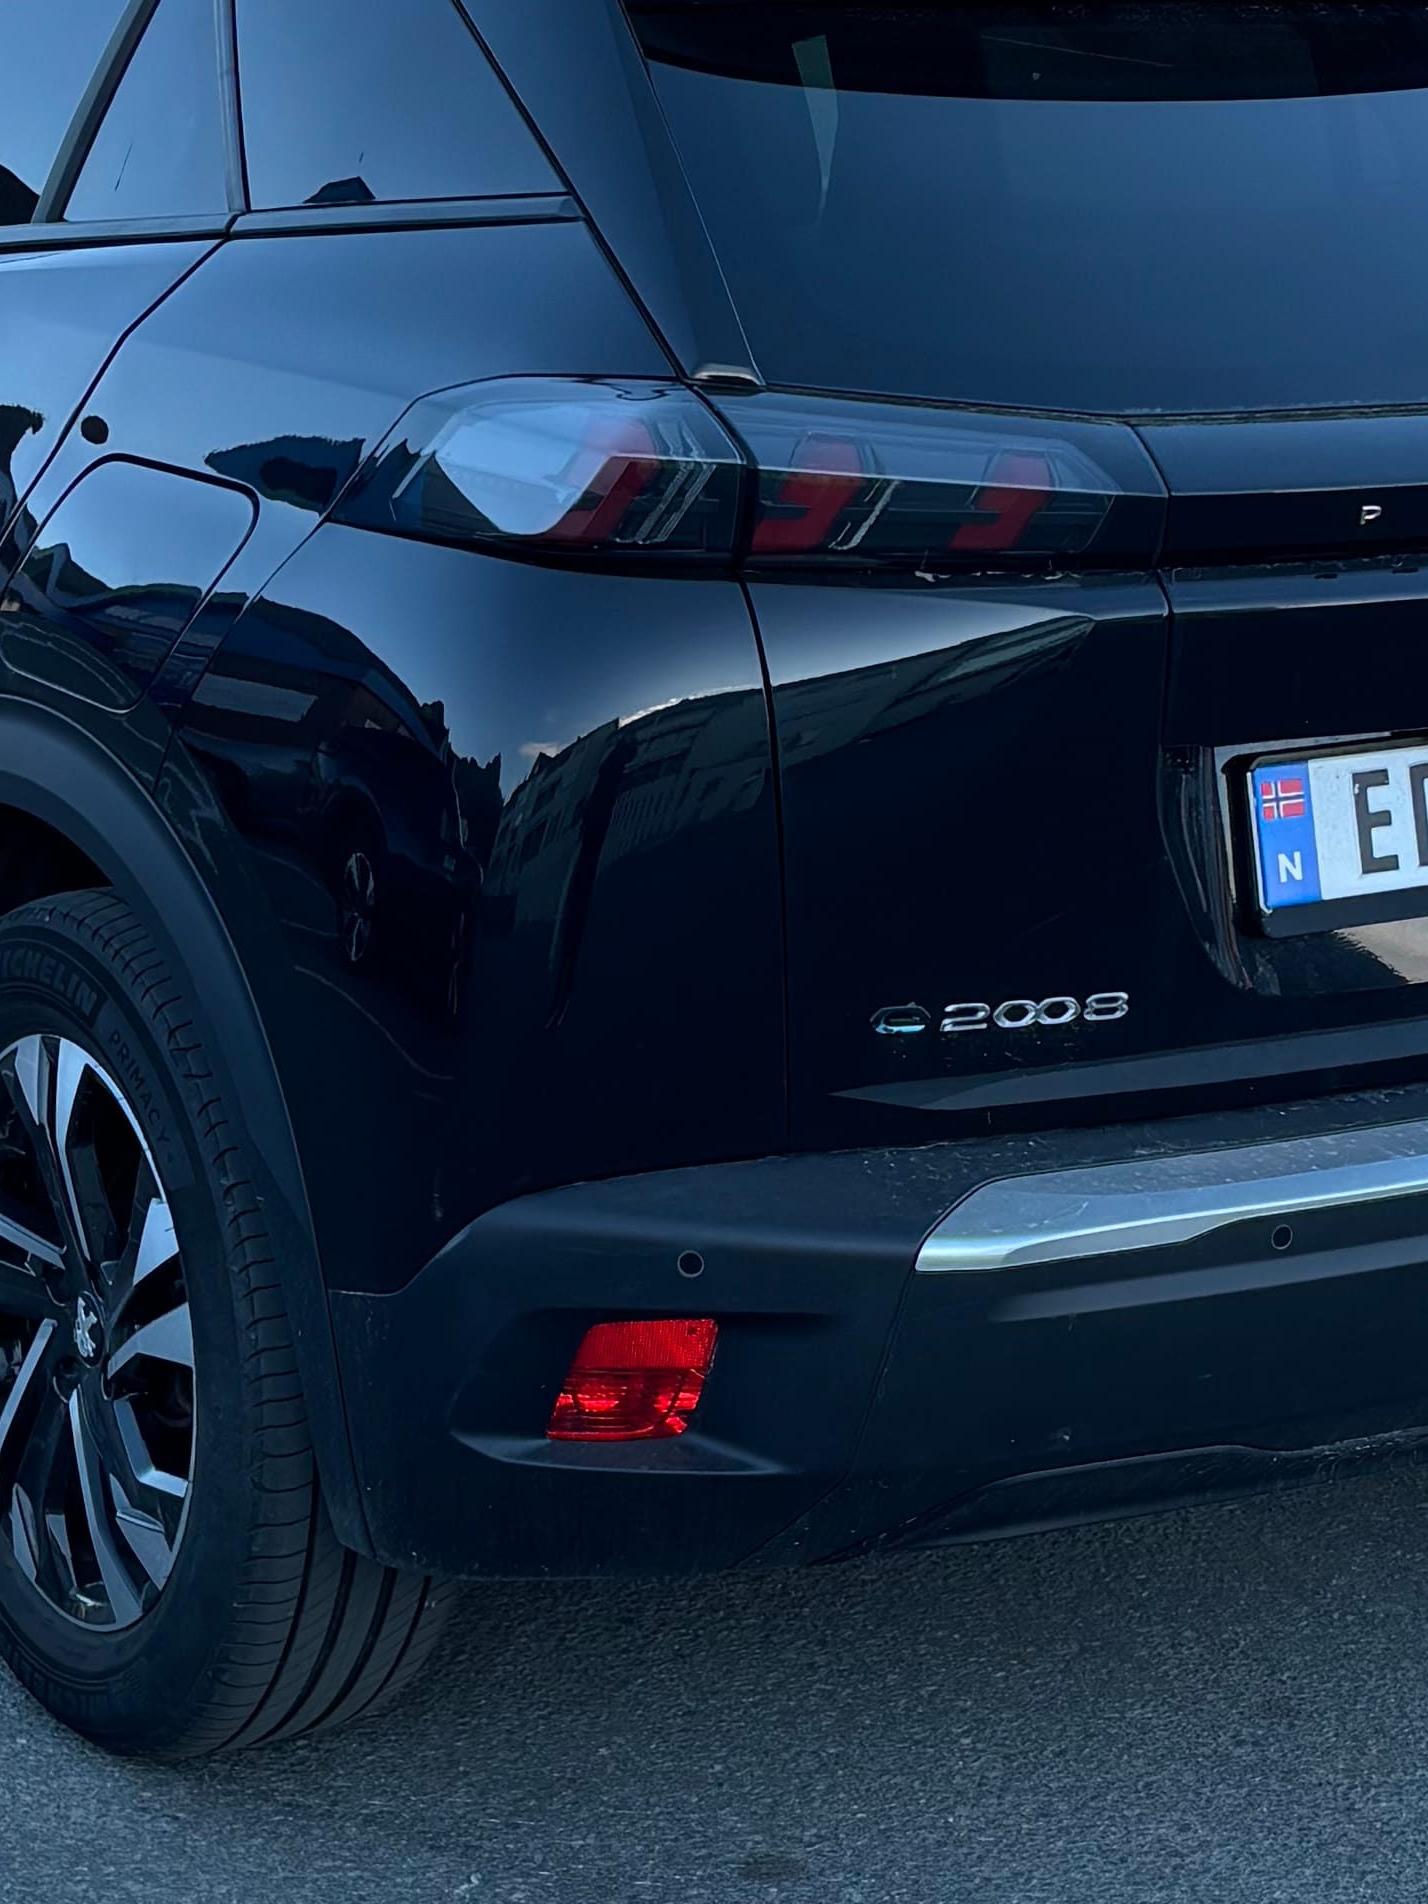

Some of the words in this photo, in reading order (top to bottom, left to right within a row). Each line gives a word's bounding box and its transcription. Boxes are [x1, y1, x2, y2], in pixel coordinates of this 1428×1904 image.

[1277, 851, 1303, 883] N
[939, 991, 1129, 1032] 2008
[109, 1028, 171, 1143] PRIMACY
